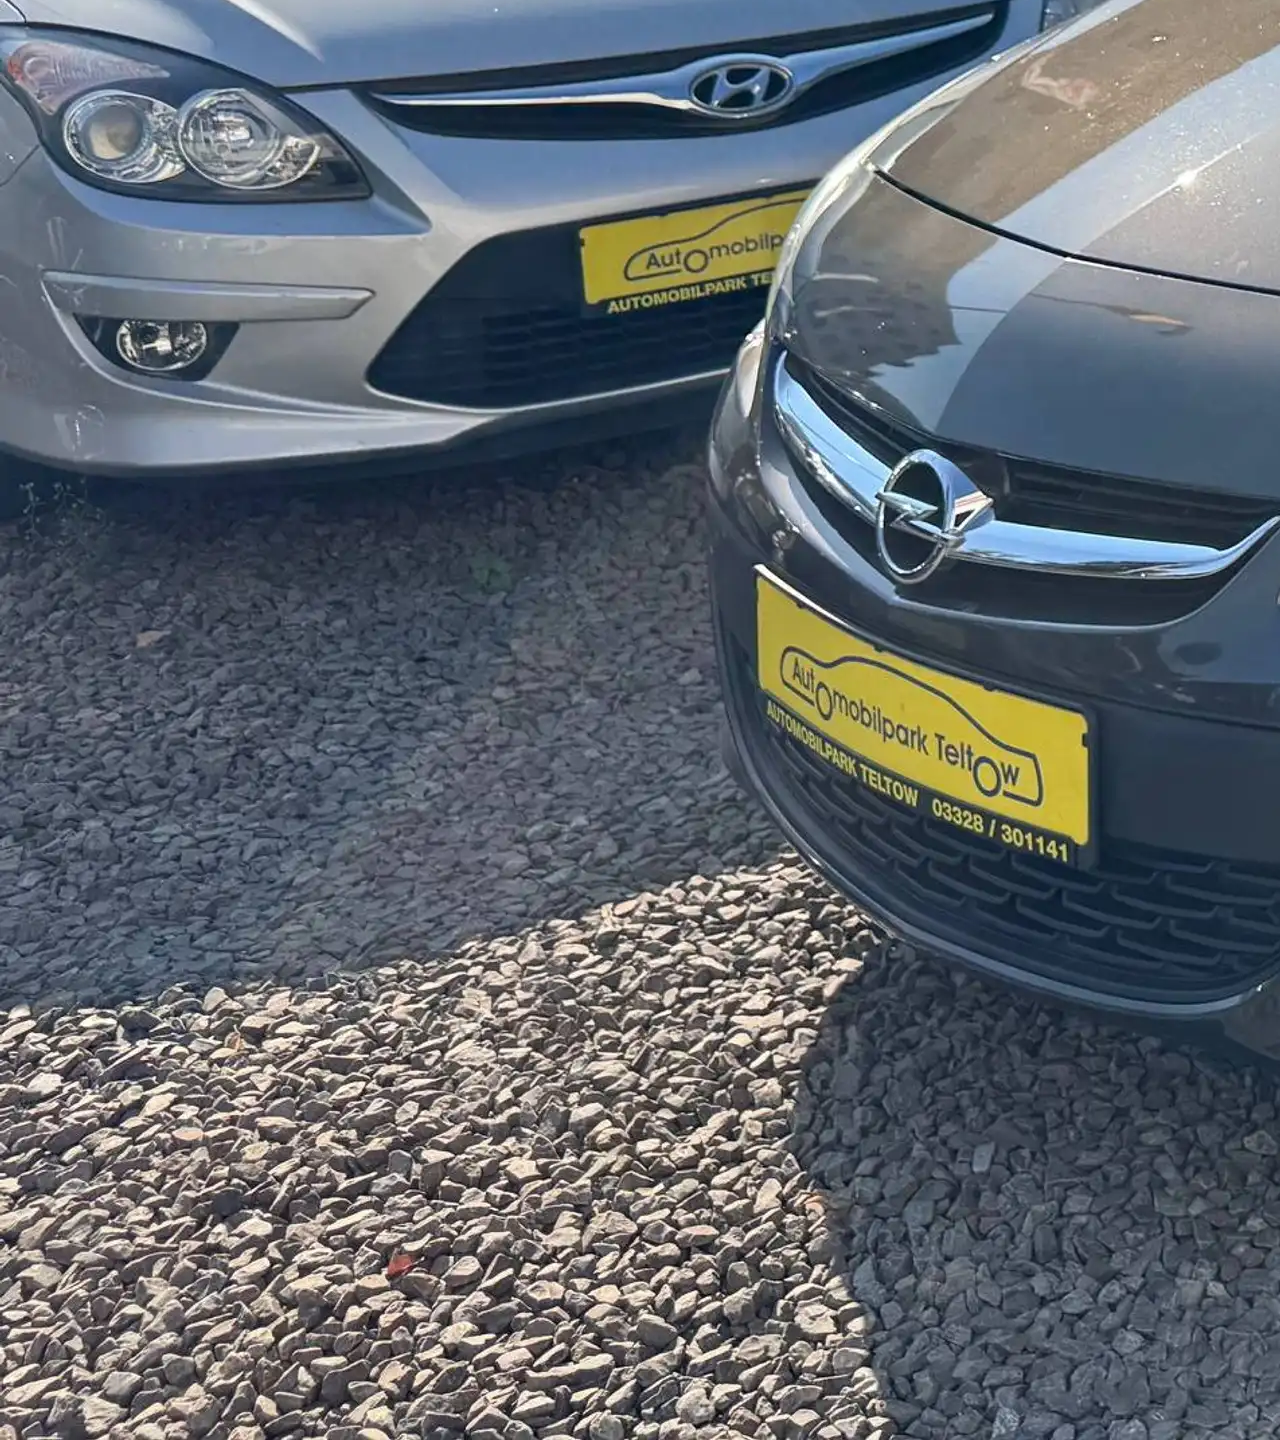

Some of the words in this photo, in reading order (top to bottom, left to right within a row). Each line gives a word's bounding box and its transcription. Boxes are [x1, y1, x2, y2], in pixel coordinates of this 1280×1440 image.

[607, 275, 748, 315] AUTOMOBILPARK
[765, 698, 859, 779] AUTOMOBILPARK
[860, 765, 920, 808] TELTOW
[932, 798, 985, 835] 03328
[1000, 823, 1069, 863] 301141
